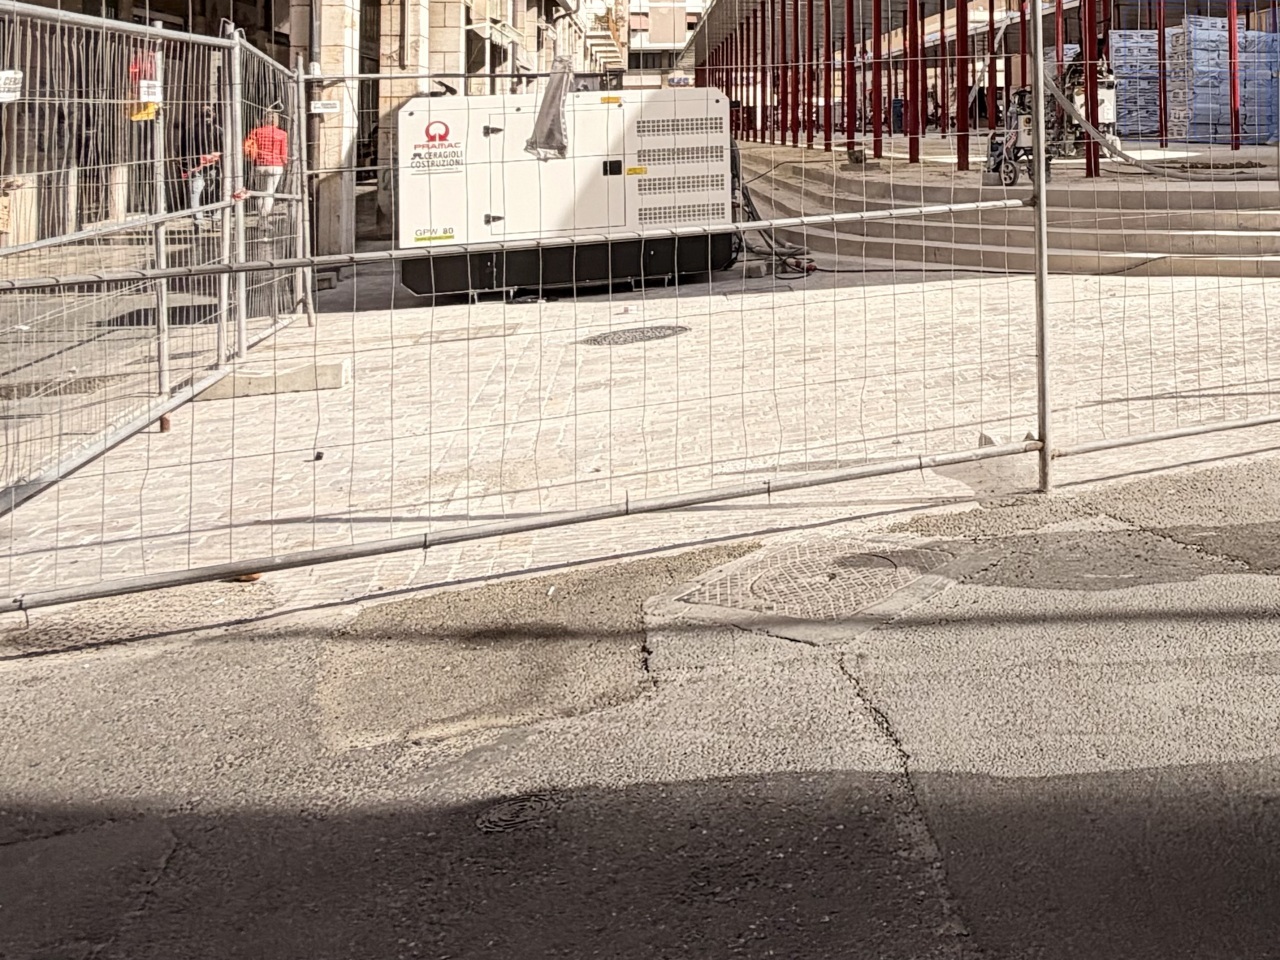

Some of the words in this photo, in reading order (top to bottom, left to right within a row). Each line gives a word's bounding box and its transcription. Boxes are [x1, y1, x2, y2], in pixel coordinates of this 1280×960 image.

[414, 142, 461, 150] PRAMAC
[424, 150, 463, 160] CERAGIOLI
[411, 159, 464, 169] COSTRUZIONI
